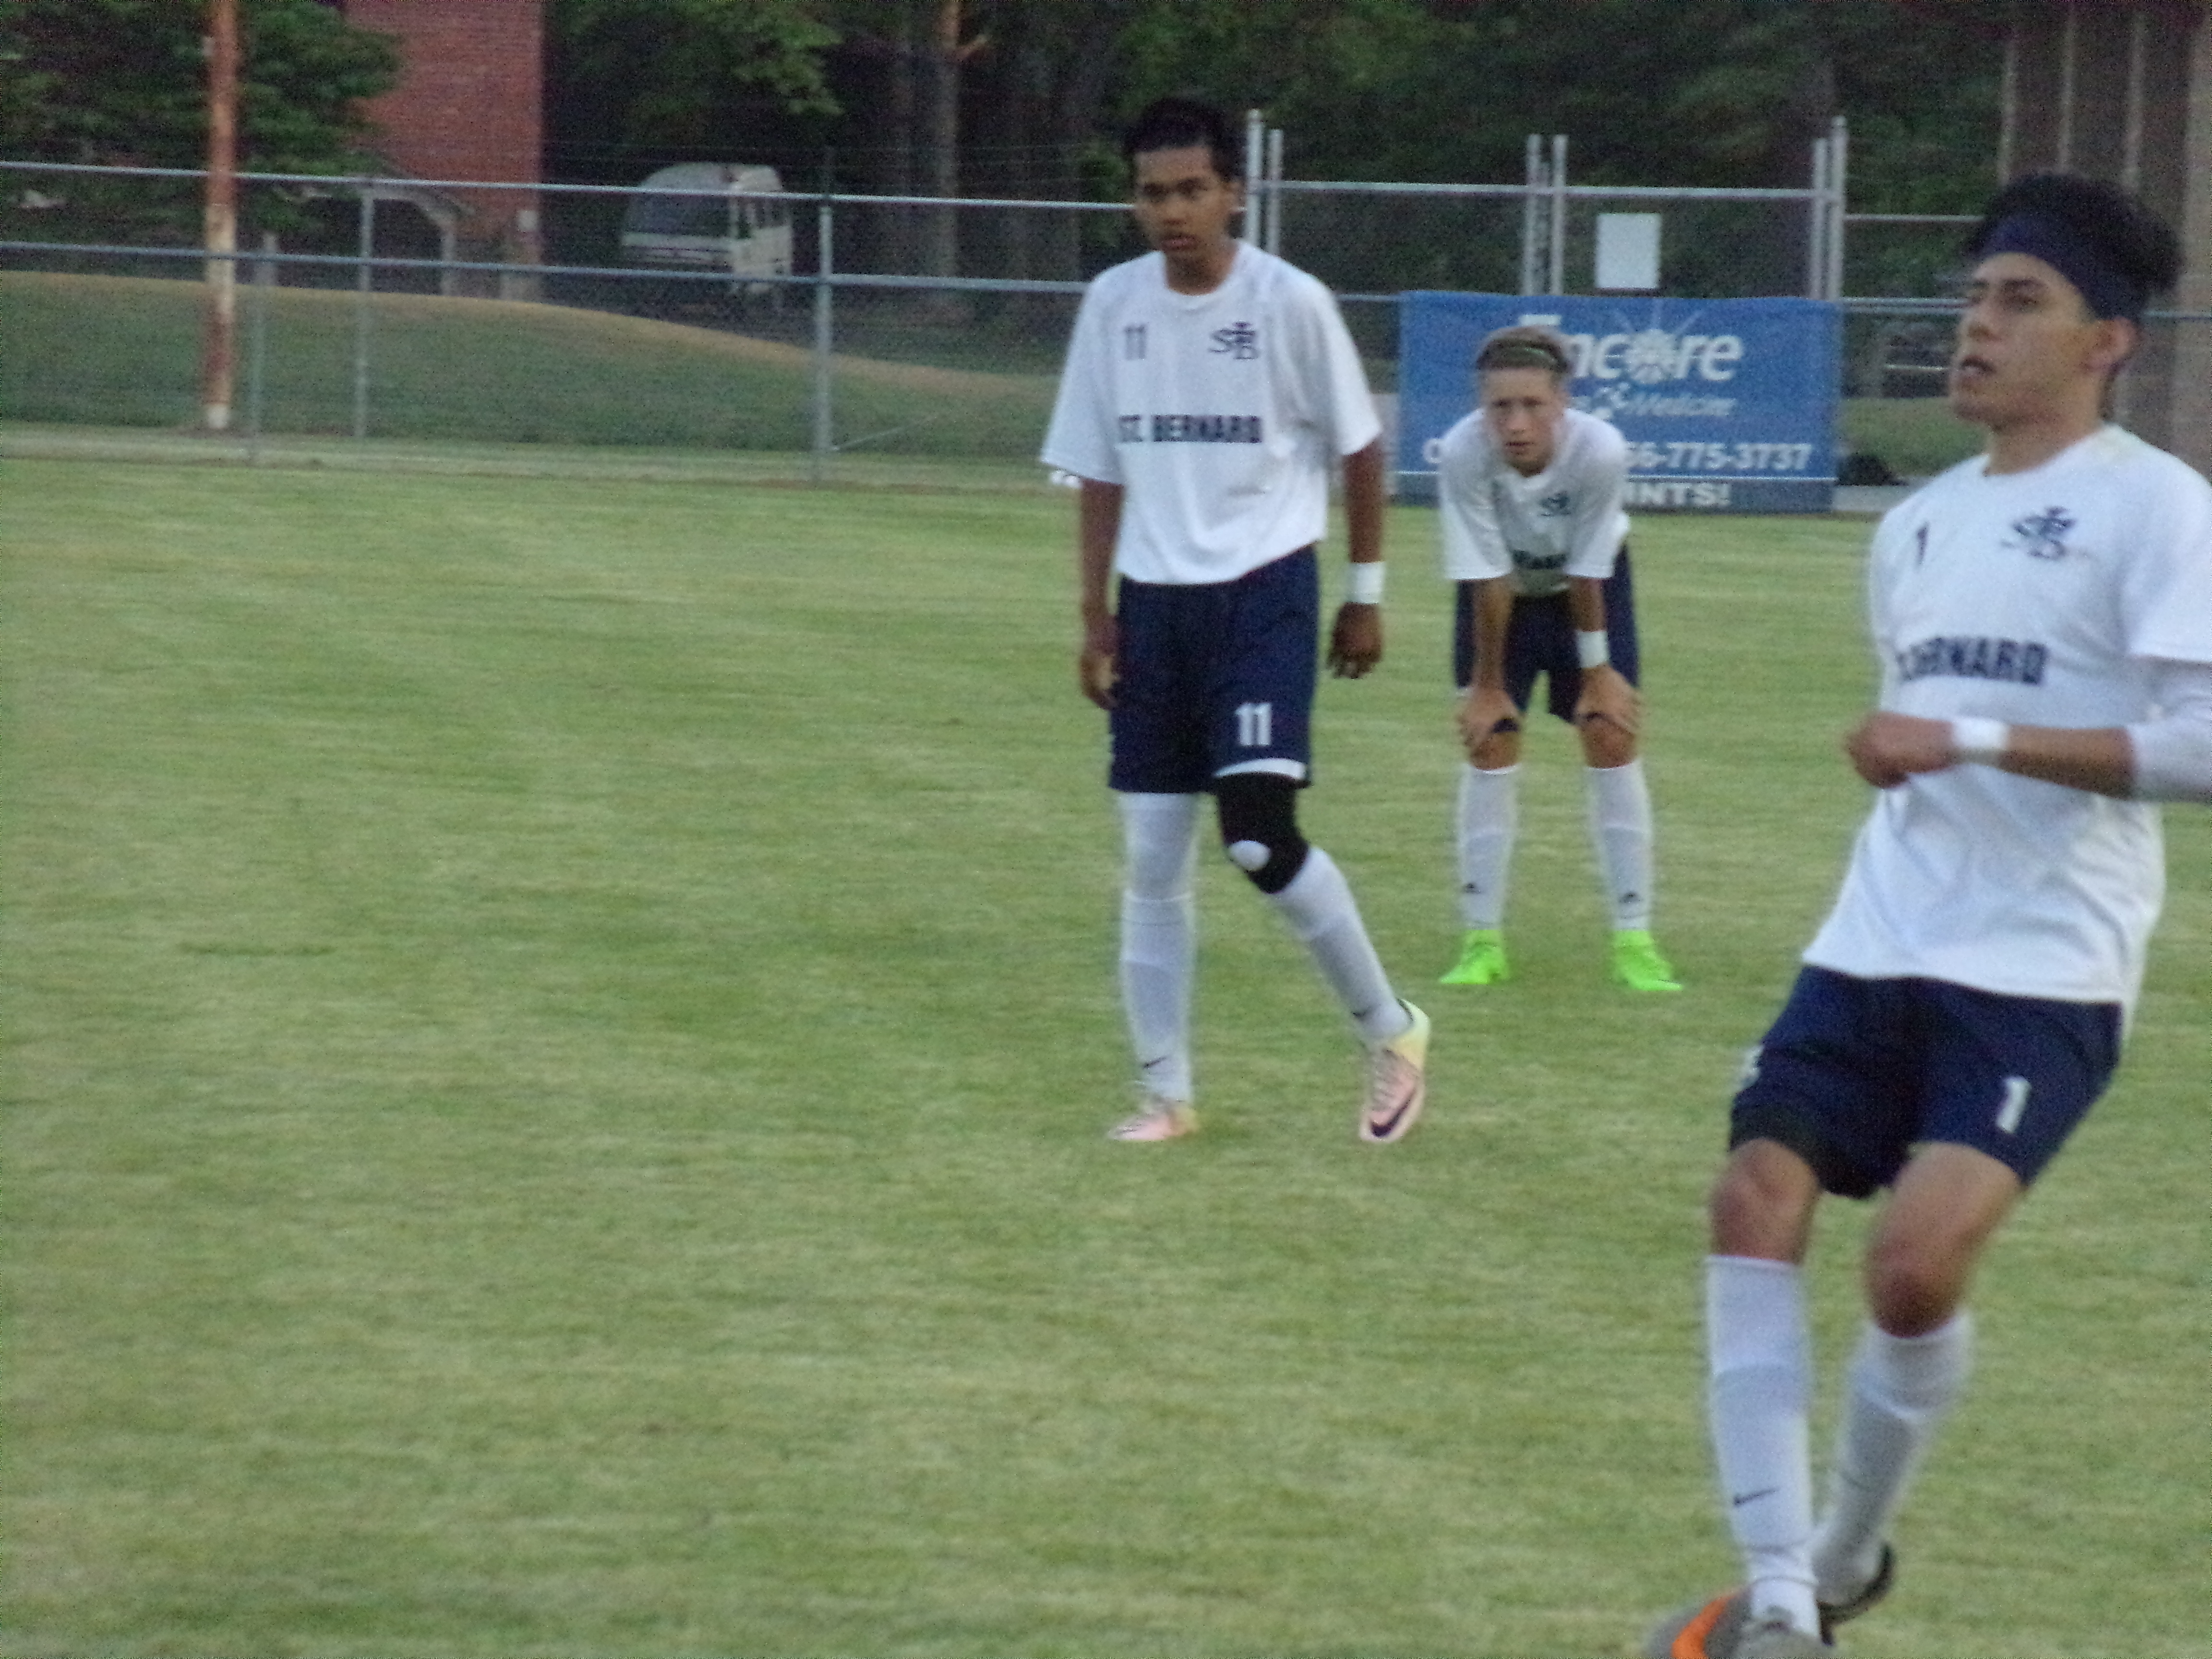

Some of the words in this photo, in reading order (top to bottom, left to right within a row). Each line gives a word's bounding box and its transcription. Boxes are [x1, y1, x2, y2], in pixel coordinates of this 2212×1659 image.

[1123, 322, 1147, 360] 11
[1236, 702, 1272, 746] 11
[1995, 1076, 2032, 1134] 1
